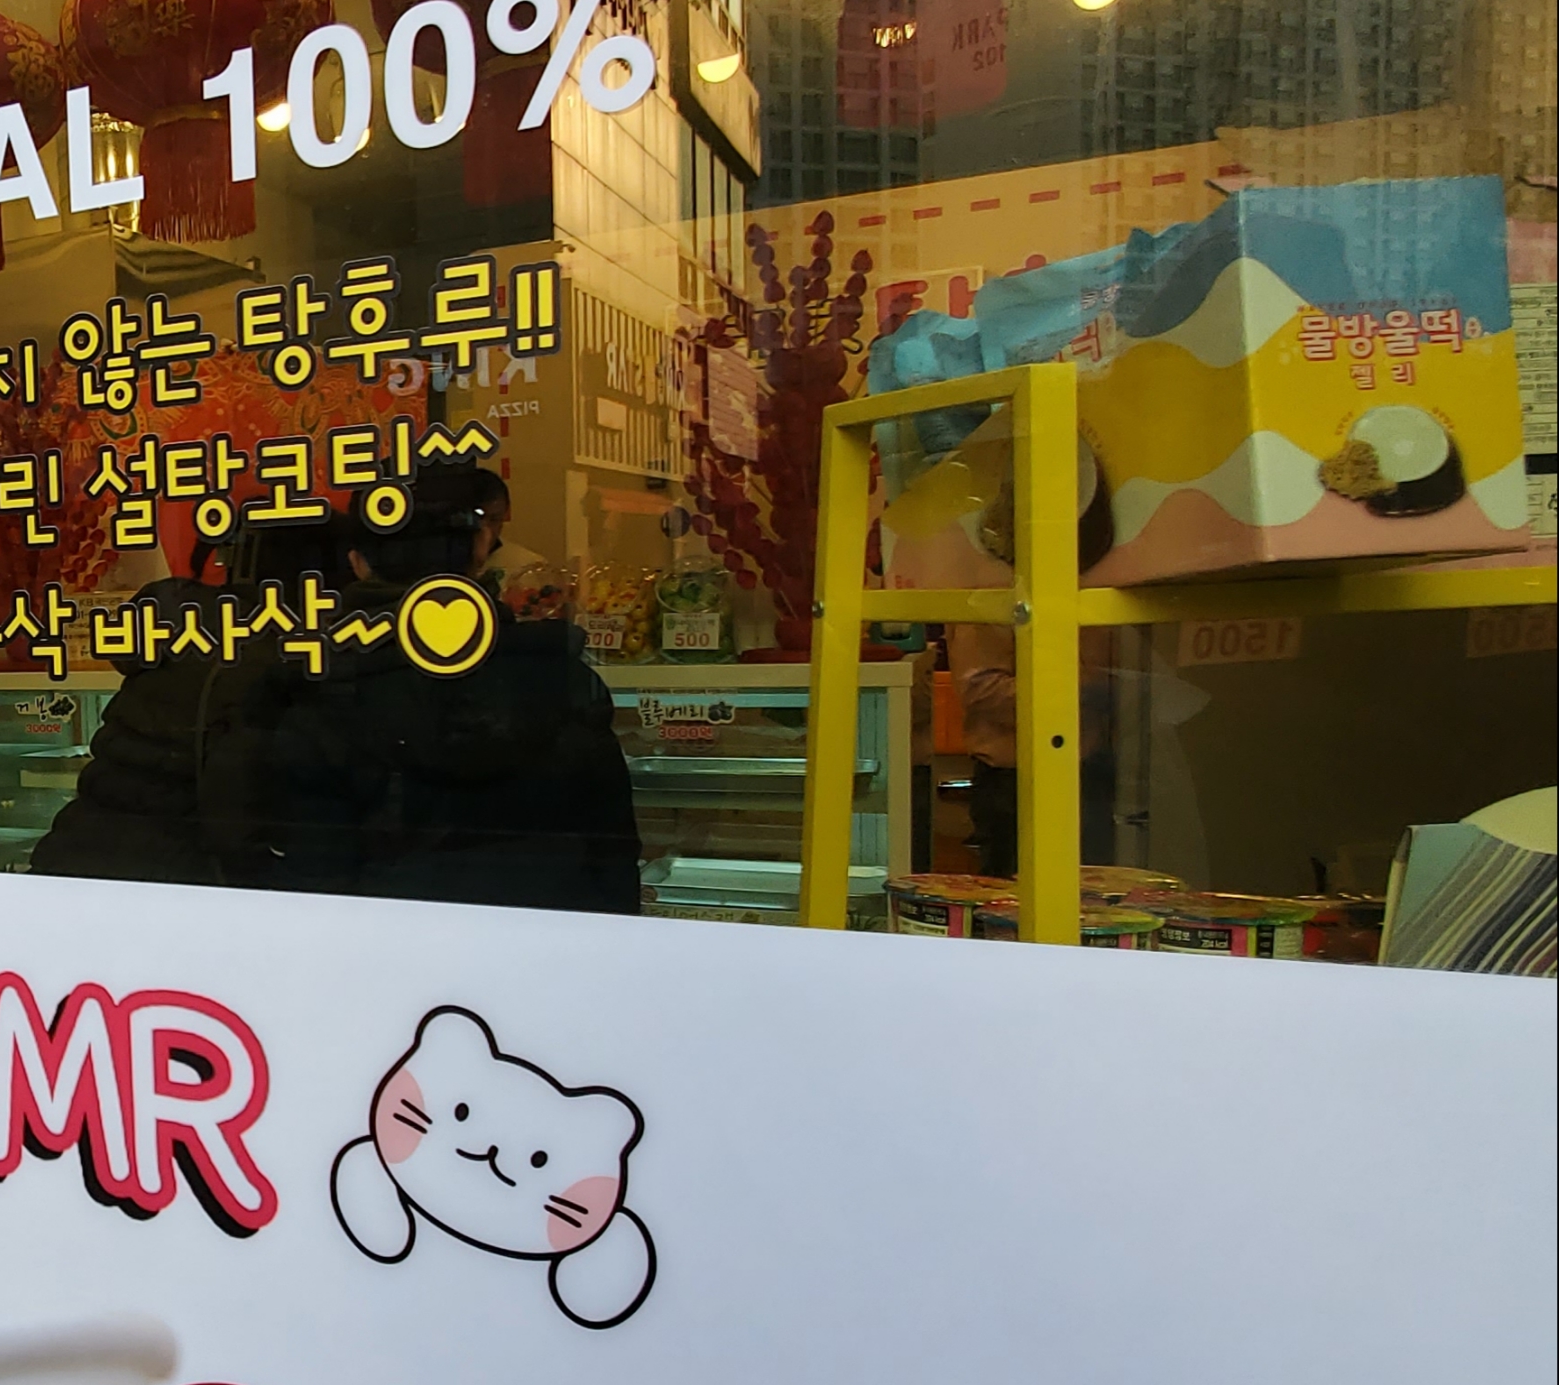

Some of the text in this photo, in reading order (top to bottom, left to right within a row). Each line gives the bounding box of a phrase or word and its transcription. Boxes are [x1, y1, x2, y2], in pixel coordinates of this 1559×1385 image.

[61, 300, 213, 412] 않는
[240, 260, 556, 388] 탕후루!!
[1298, 307, 1464, 361] 물방울떡
[639, 698, 704, 726] 블루베리
